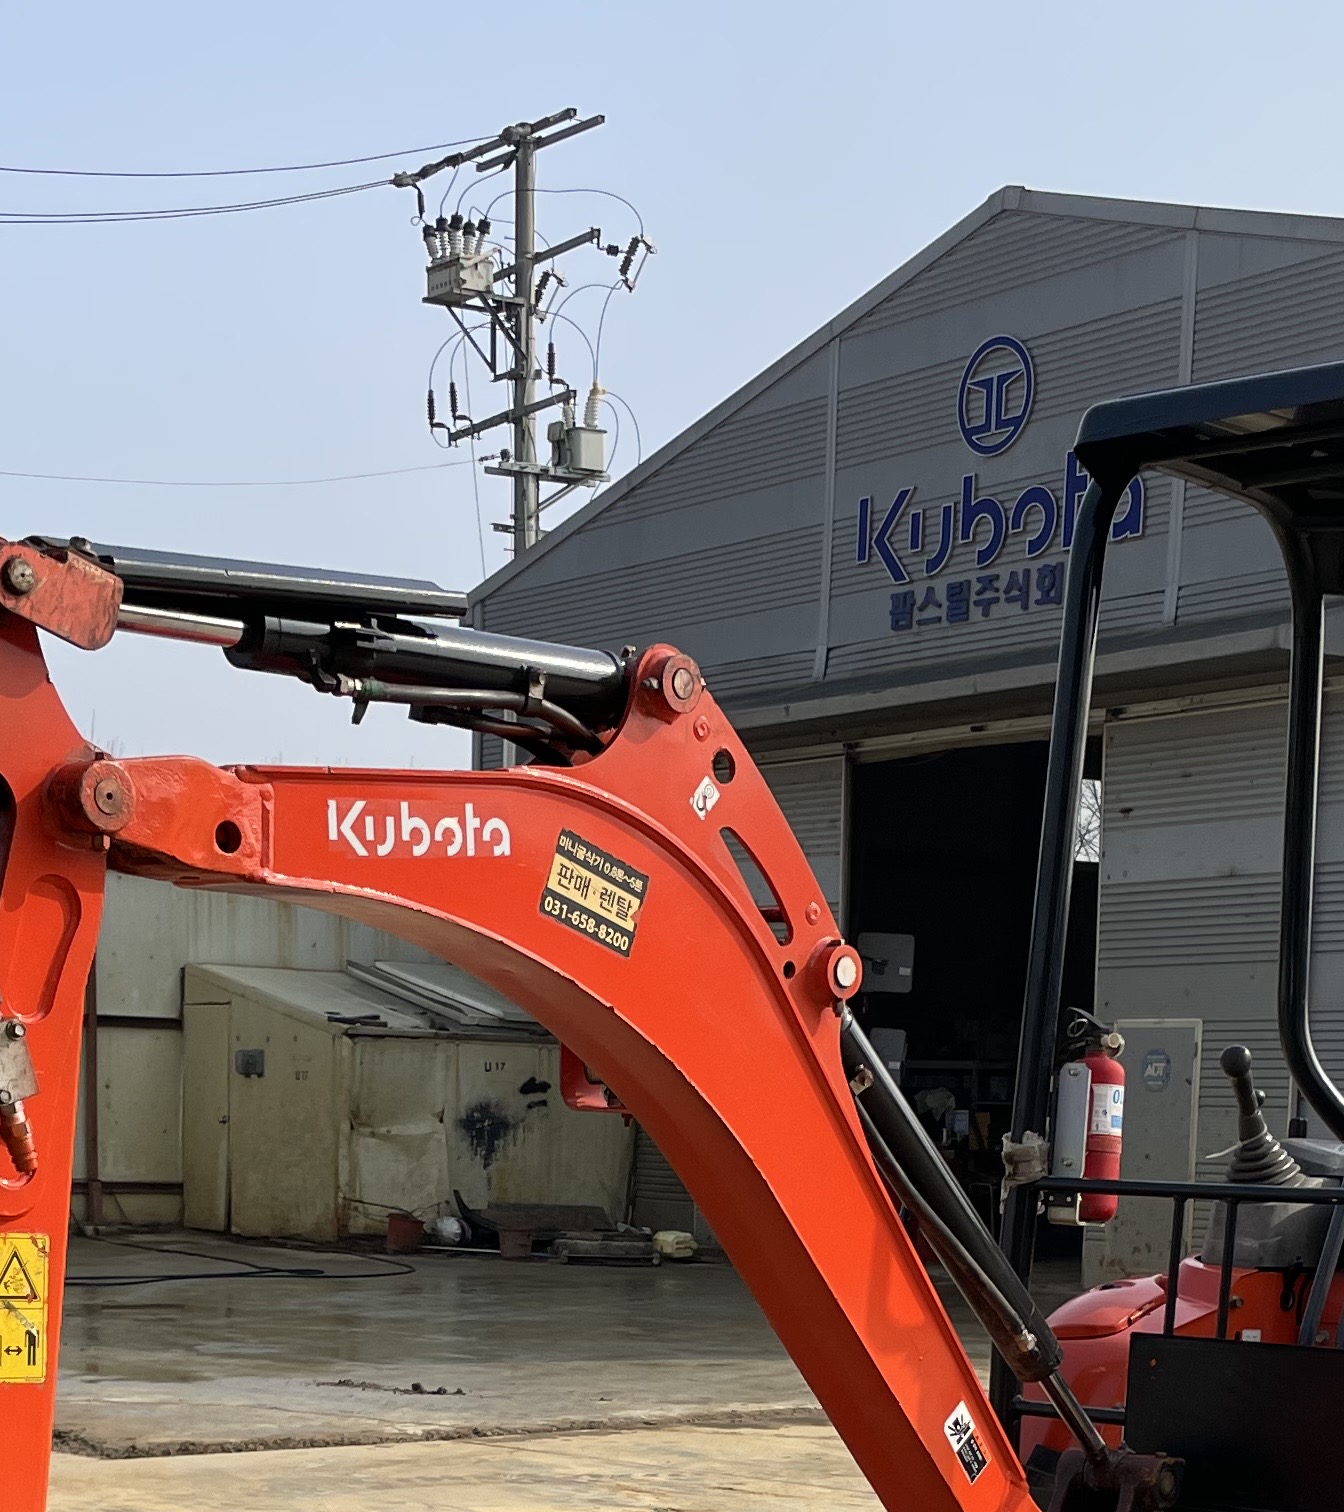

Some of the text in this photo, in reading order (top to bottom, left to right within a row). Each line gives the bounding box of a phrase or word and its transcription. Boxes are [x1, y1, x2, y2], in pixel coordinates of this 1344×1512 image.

[327, 799, 512, 858] Kubota
[557, 862, 633, 923] 판매 렌탈
[544, 896, 629, 951] 031-658-8200
